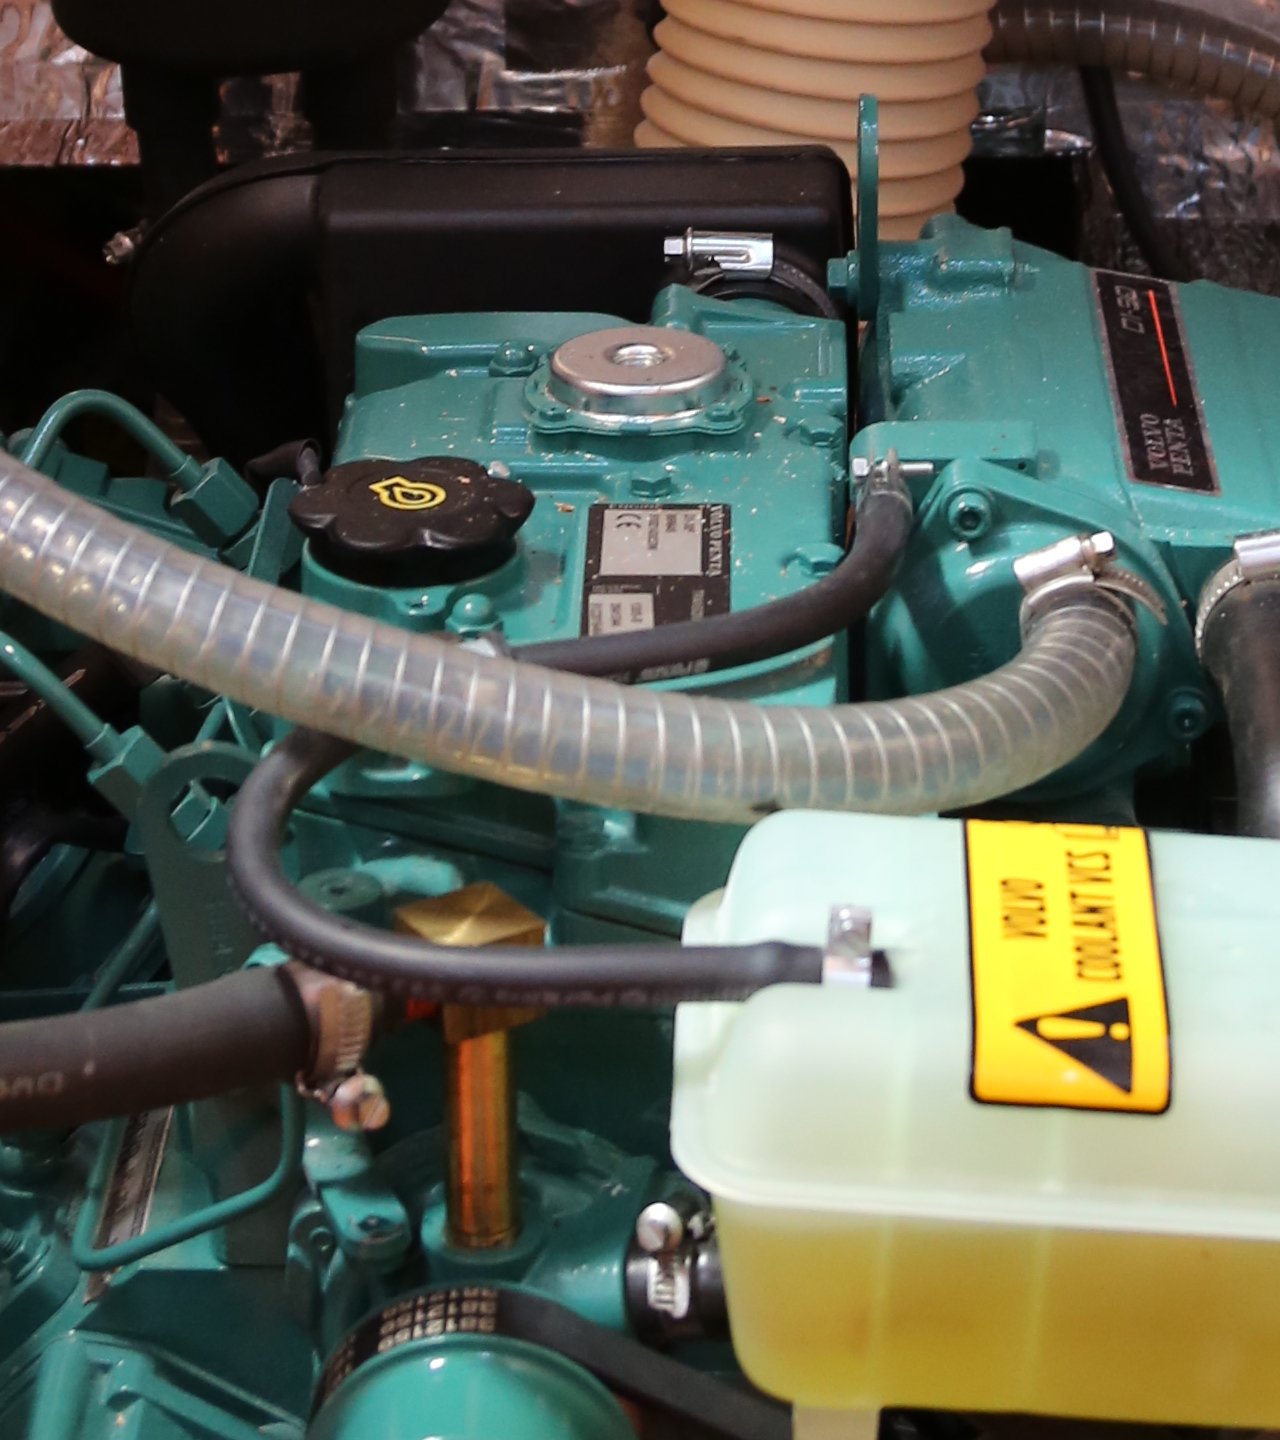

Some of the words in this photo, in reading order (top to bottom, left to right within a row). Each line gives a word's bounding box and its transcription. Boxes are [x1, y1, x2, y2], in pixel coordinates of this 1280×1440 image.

[1140, 412, 1168, 470] VOLVO
[1163, 418, 1194, 476] PENTA
[1066, 850, 1113, 884] VCS
[1001, 878, 1048, 939] VOLVO
[1069, 894, 1122, 982] COOLANT
